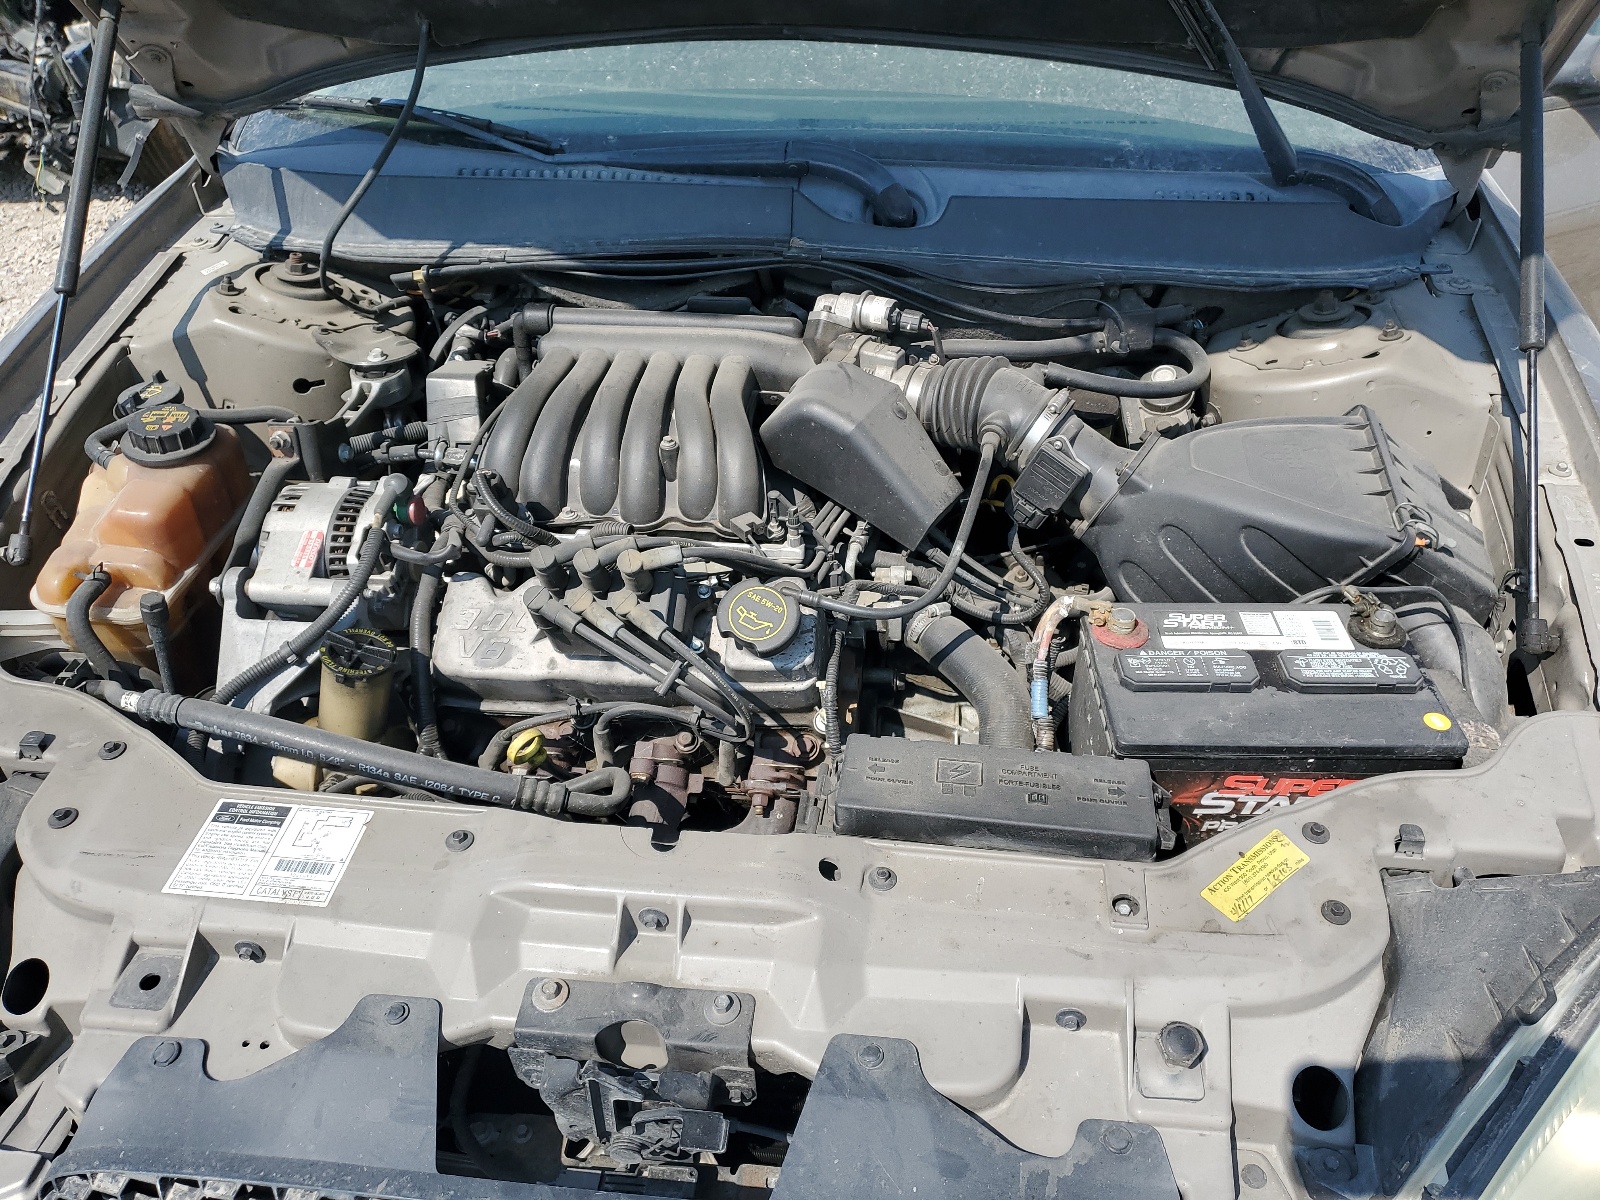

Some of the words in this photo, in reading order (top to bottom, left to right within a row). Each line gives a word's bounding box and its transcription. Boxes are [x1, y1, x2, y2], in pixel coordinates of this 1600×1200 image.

[747, 592, 761, 603] SAE
[761, 598, 783, 613] 5W-20
[454, 607, 527, 633] 3.0L
[1163, 619, 1228, 628] START
[1168, 612, 1226, 620] SUPER
[459, 635, 511, 660] V6
[1001, 768, 1058, 779] COMPARTMENT
[1020, 764, 1039, 772] FUSE
[358, 762, 391, 779] R134a
[393, 771, 418, 784] SAE
[458, 787, 490, 800] TYPE
[248, 808, 279, 816] INFORMATION
[1192, 792, 1314, 815] STA
[1207, 873, 1234, 896] ACTION
[1229, 835, 1279, 875] TRANSMISSIONS
